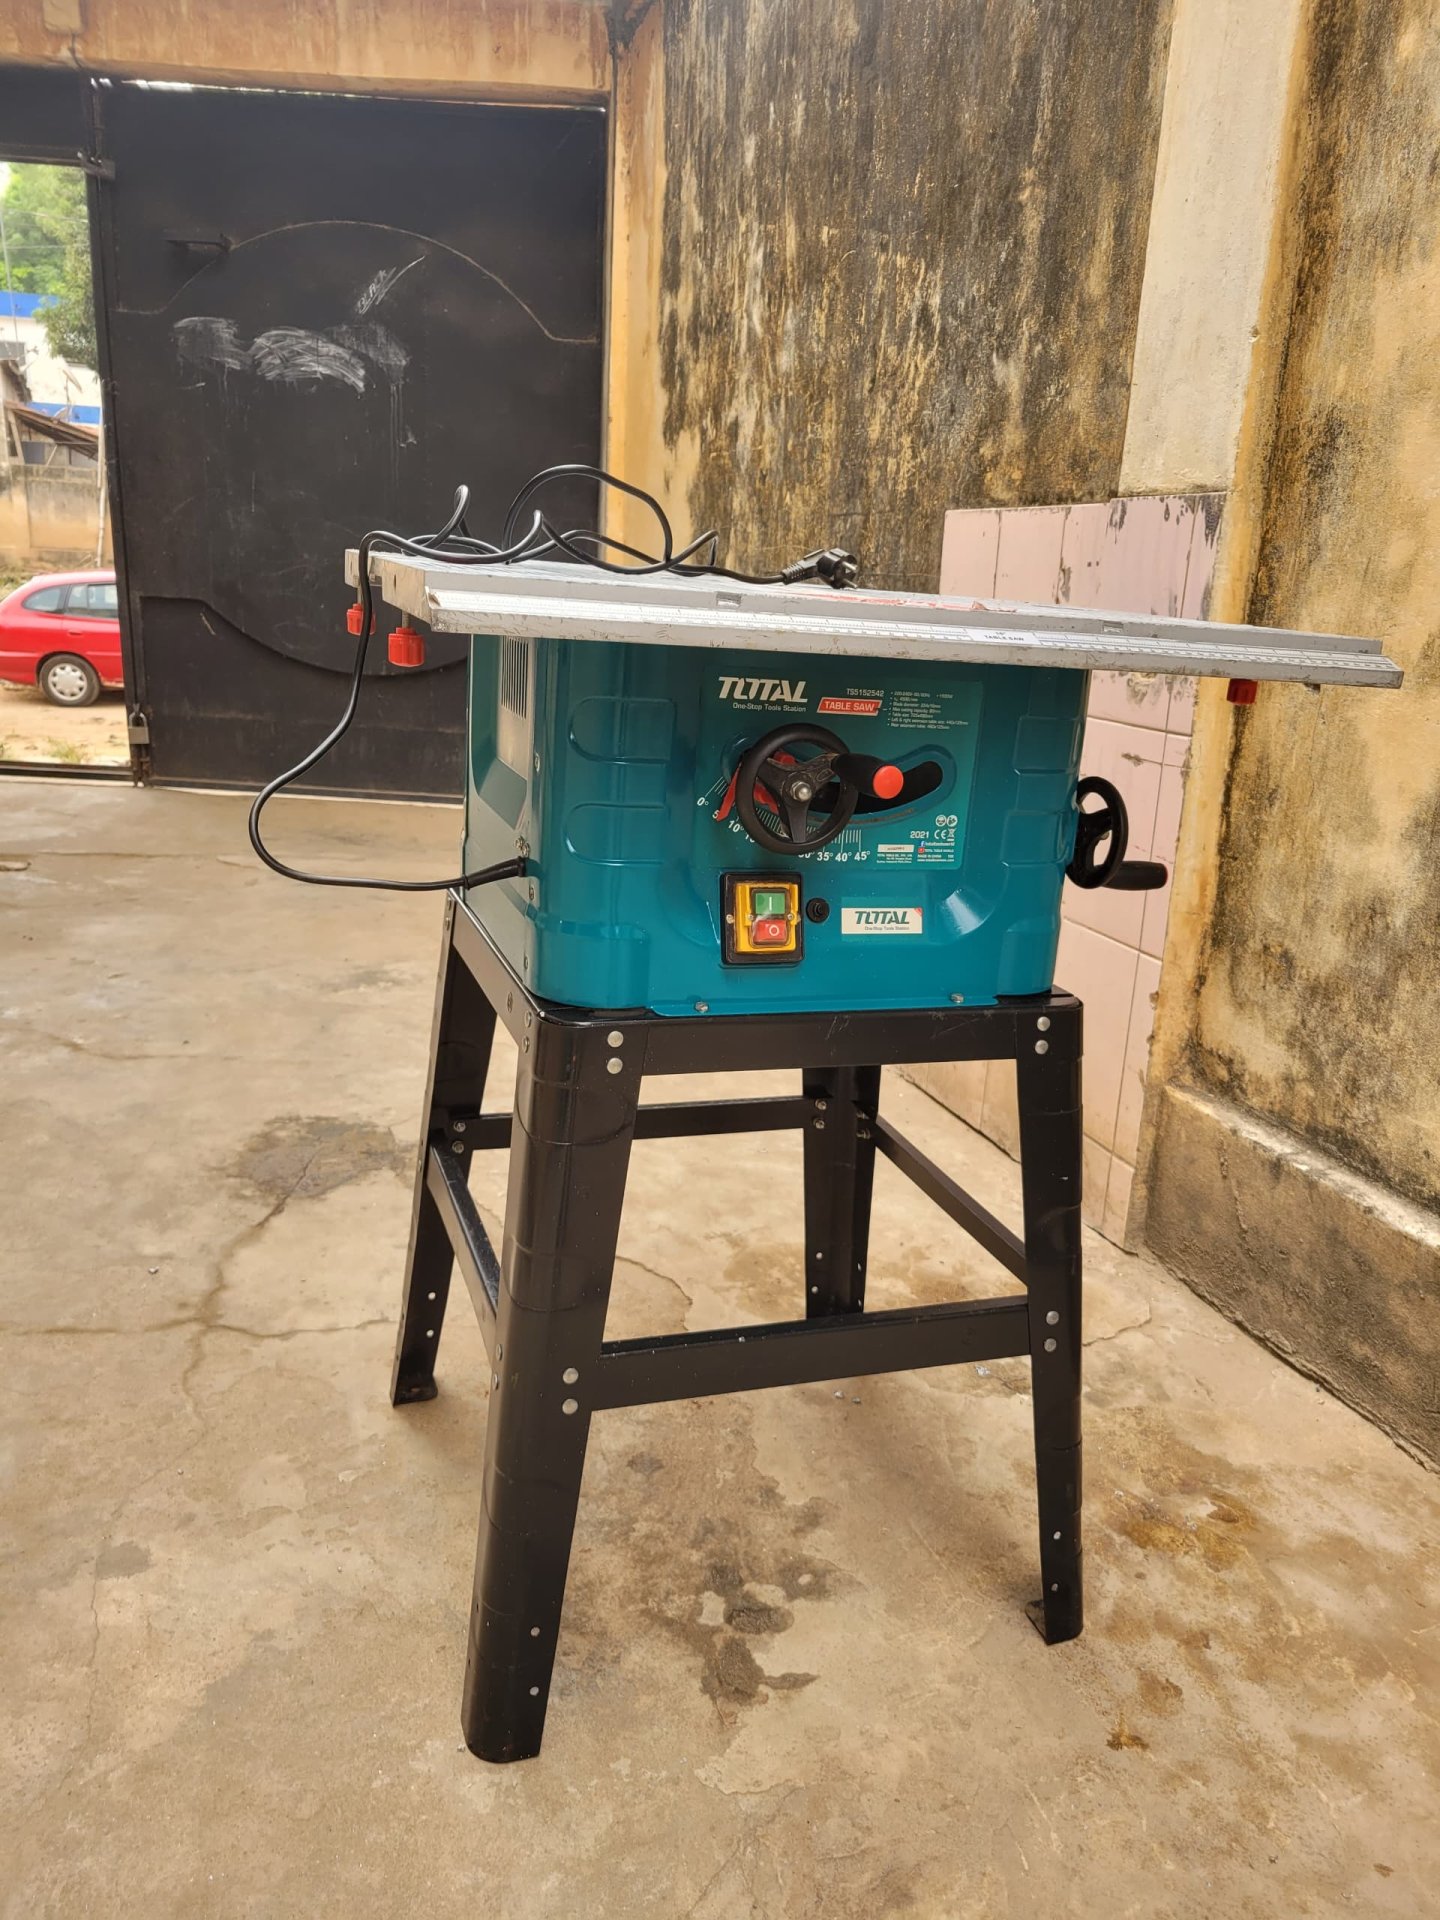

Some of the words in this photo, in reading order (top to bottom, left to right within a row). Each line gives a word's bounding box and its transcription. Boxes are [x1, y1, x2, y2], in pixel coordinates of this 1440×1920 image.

[718, 676, 808, 703] TOTAL
[732, 702, 762, 711] One-Stop
[764, 703, 781, 712] Tools
[783, 704, 807, 713] Station
[825, 701, 851, 710] TABLE
[853, 702, 875, 712] SAW
[910, 830, 929, 839] 2021
[854, 911, 910, 925] TOTAL
